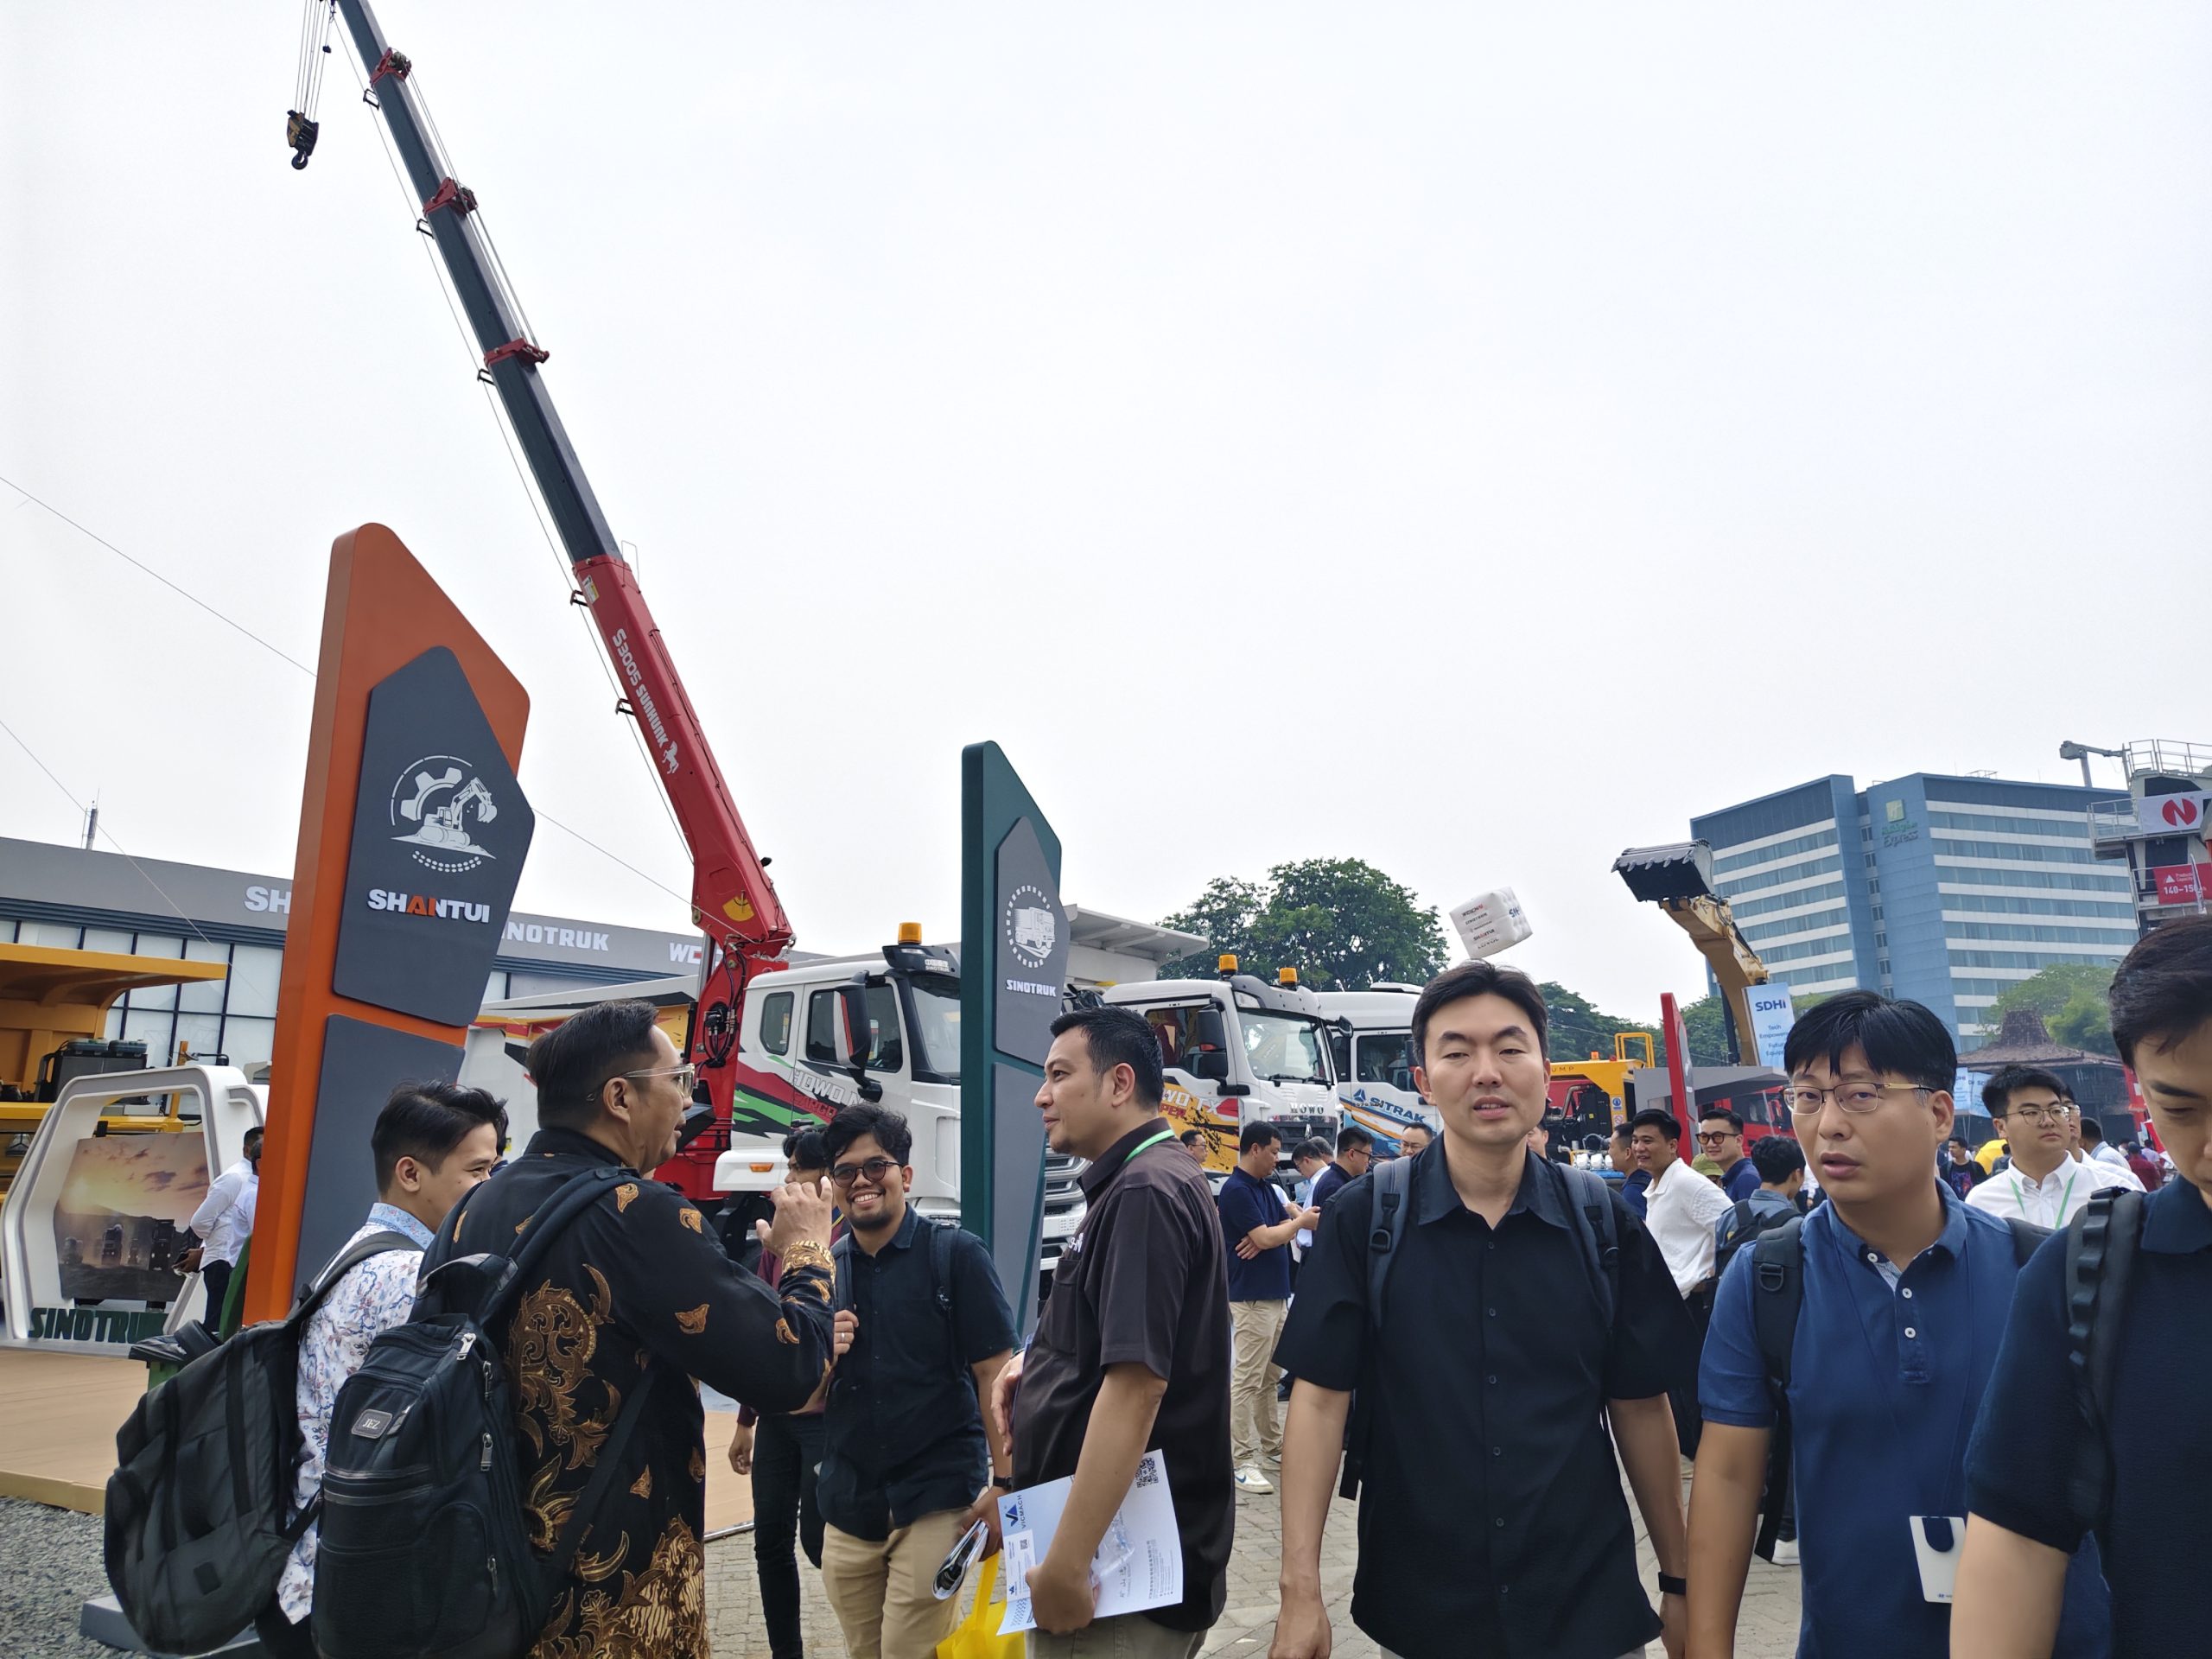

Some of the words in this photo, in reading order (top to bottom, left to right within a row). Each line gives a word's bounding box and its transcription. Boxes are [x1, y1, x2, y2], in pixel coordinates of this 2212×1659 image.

[612, 628, 642, 686] S3005
[636, 684, 669, 748] SUNHUNK
[2164, 884, 2195, 895] 140-15
[367, 888, 490, 924] SHANTUI
[1006, 979, 1057, 997] SINOTRUK
[1162, 1089, 1190, 1108] WO
[1289, 1103, 1325, 1116] HOWO
[1370, 1096, 1427, 1123] SITRAK
[1018, 1495, 1027, 1529] VICMACH
